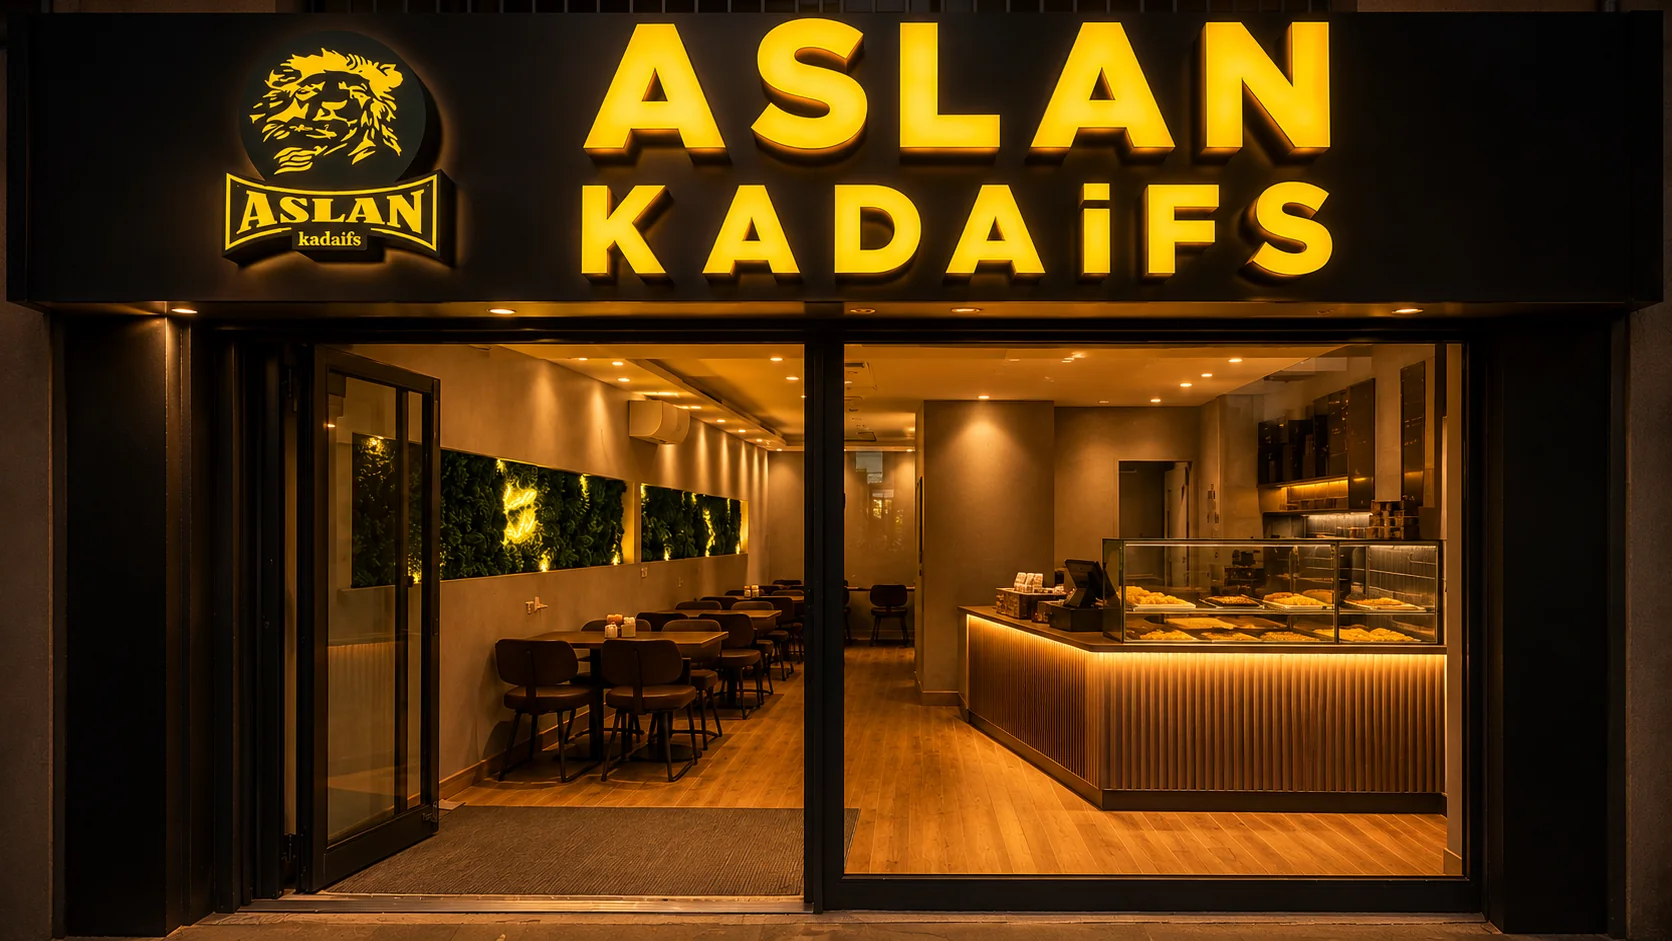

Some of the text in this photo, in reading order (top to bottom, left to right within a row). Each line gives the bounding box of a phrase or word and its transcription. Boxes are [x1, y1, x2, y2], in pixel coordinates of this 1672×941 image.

[583, 17, 1332, 150] ASLAN
[236, 189, 425, 235] ASLAN
[298, 231, 362, 247] kadaifs
